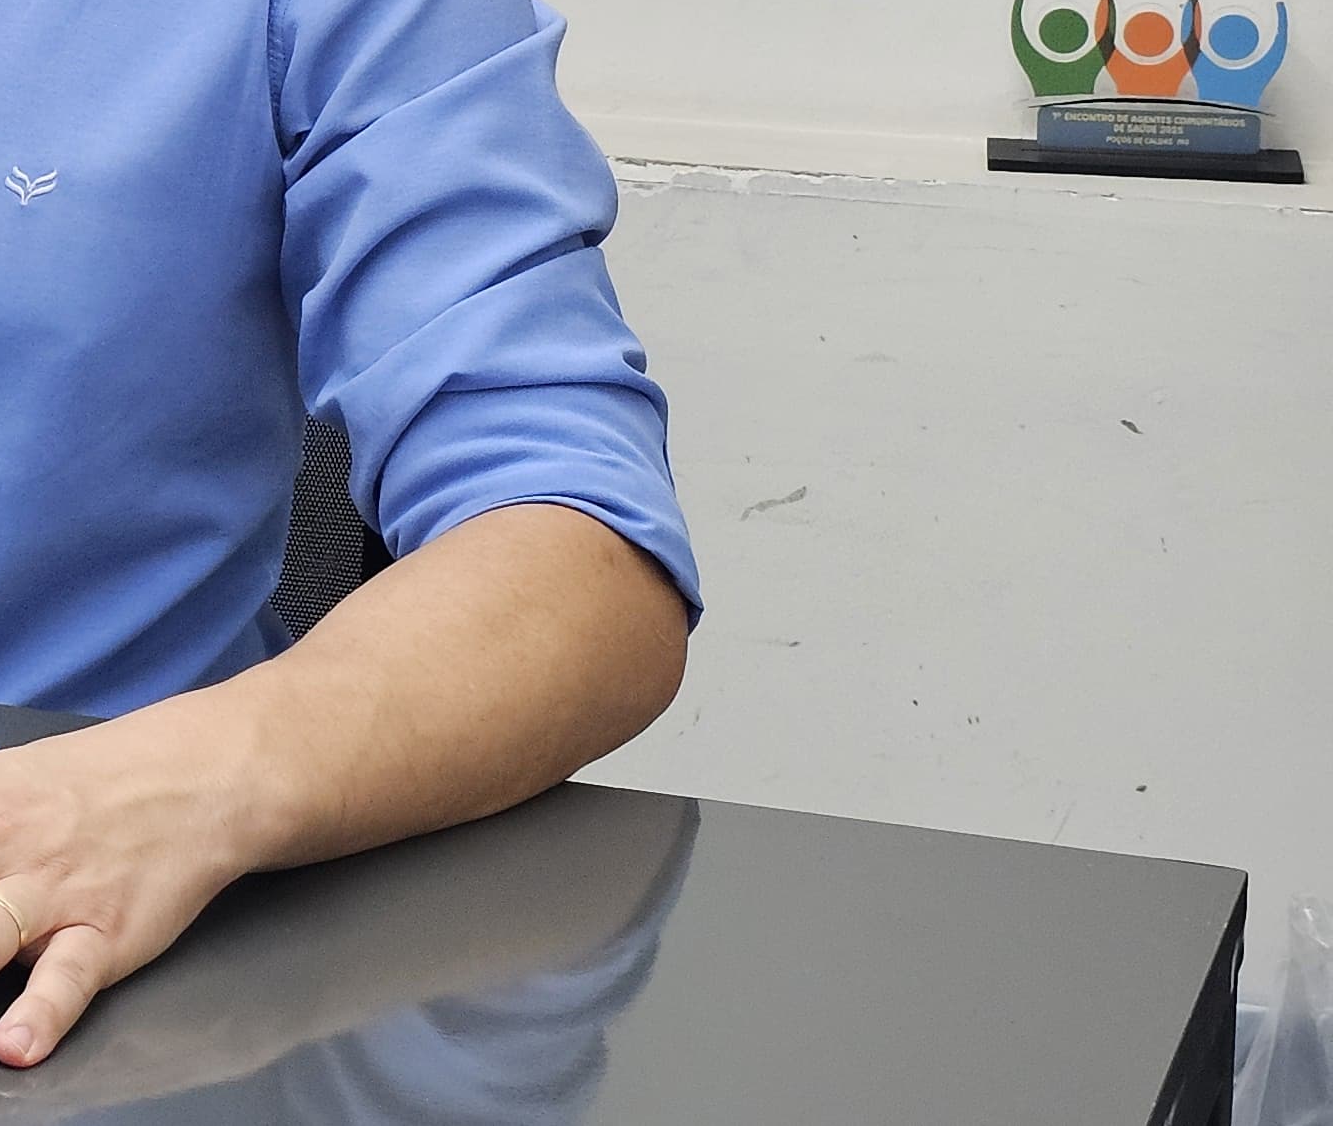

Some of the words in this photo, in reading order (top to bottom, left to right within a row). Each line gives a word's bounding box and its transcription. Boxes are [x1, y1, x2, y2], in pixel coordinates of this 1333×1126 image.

[1064, 112, 1115, 123] ENCONTRO
[1116, 113, 1129, 123] DE
[1131, 113, 1172, 125] AGENTES
[1113, 124, 1125, 133] DE
[1127, 123, 1157, 134] SAÚDE
